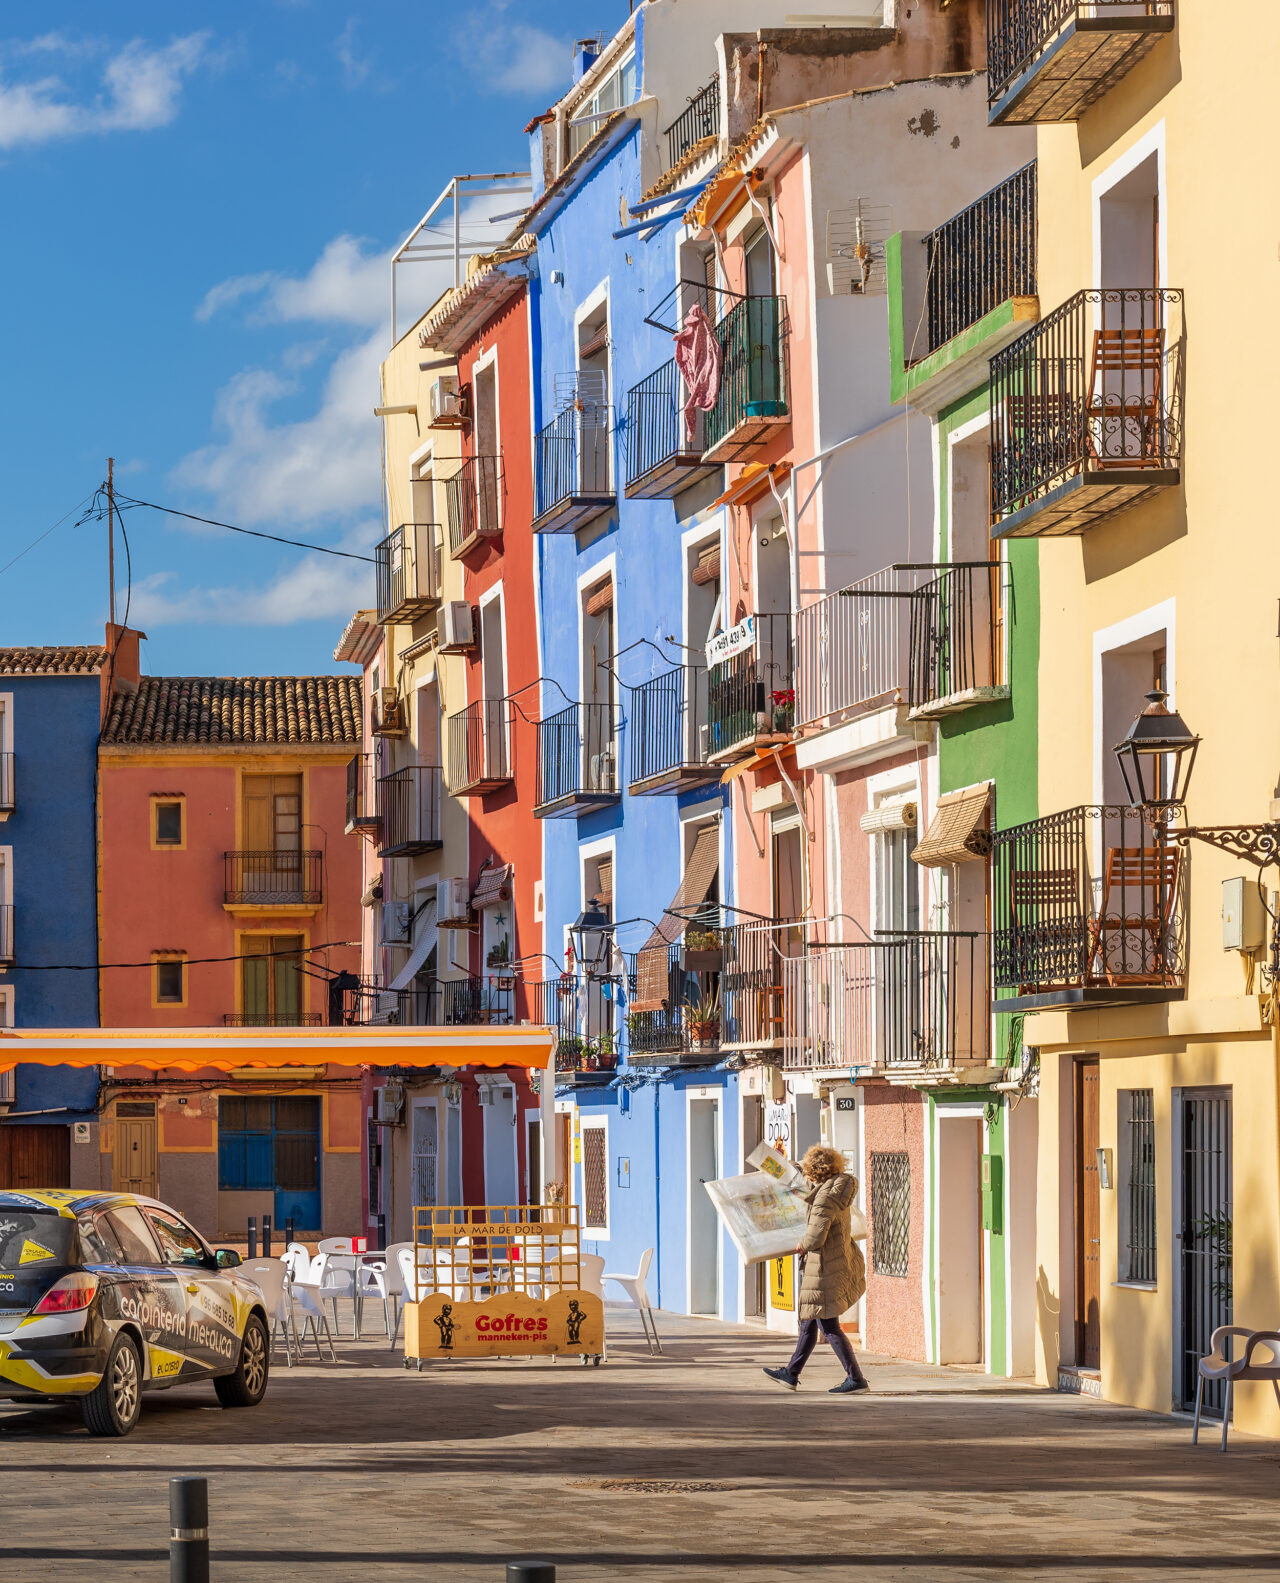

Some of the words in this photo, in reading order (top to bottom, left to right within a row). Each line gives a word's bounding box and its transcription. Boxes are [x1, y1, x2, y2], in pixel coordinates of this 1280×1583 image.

[839, 1100, 852, 1109] 30
[453, 1226, 466, 1235] LA
[471, 1226, 495, 1235] MAR
[498, 1226, 511, 1235] DE
[475, 1313, 548, 1332] Gofres
[477, 1331, 548, 1342] manneken-pis
